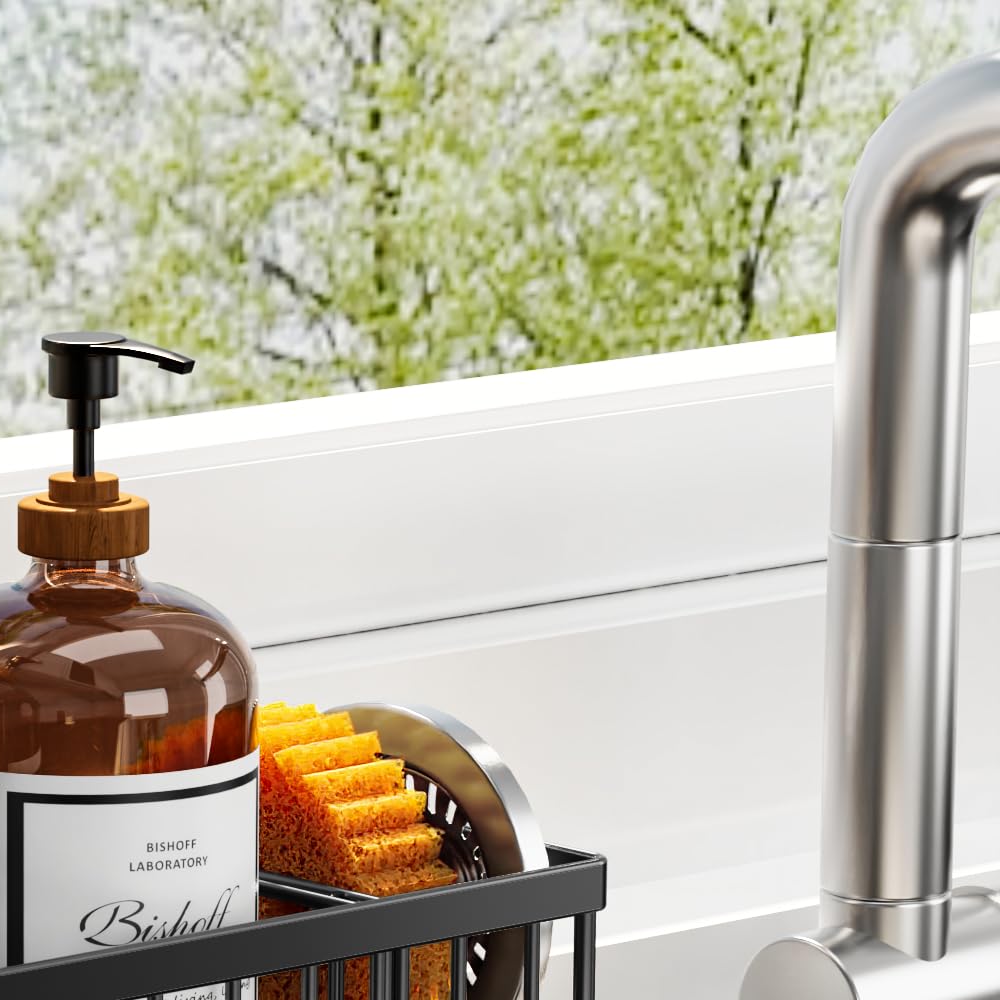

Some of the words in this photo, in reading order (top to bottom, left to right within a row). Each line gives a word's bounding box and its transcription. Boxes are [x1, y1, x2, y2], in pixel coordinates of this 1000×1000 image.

[146, 838, 198, 853] BISHOFF
[129, 855, 209, 873] LABORATORY
[79, 885, 240, 948] Bishoff
